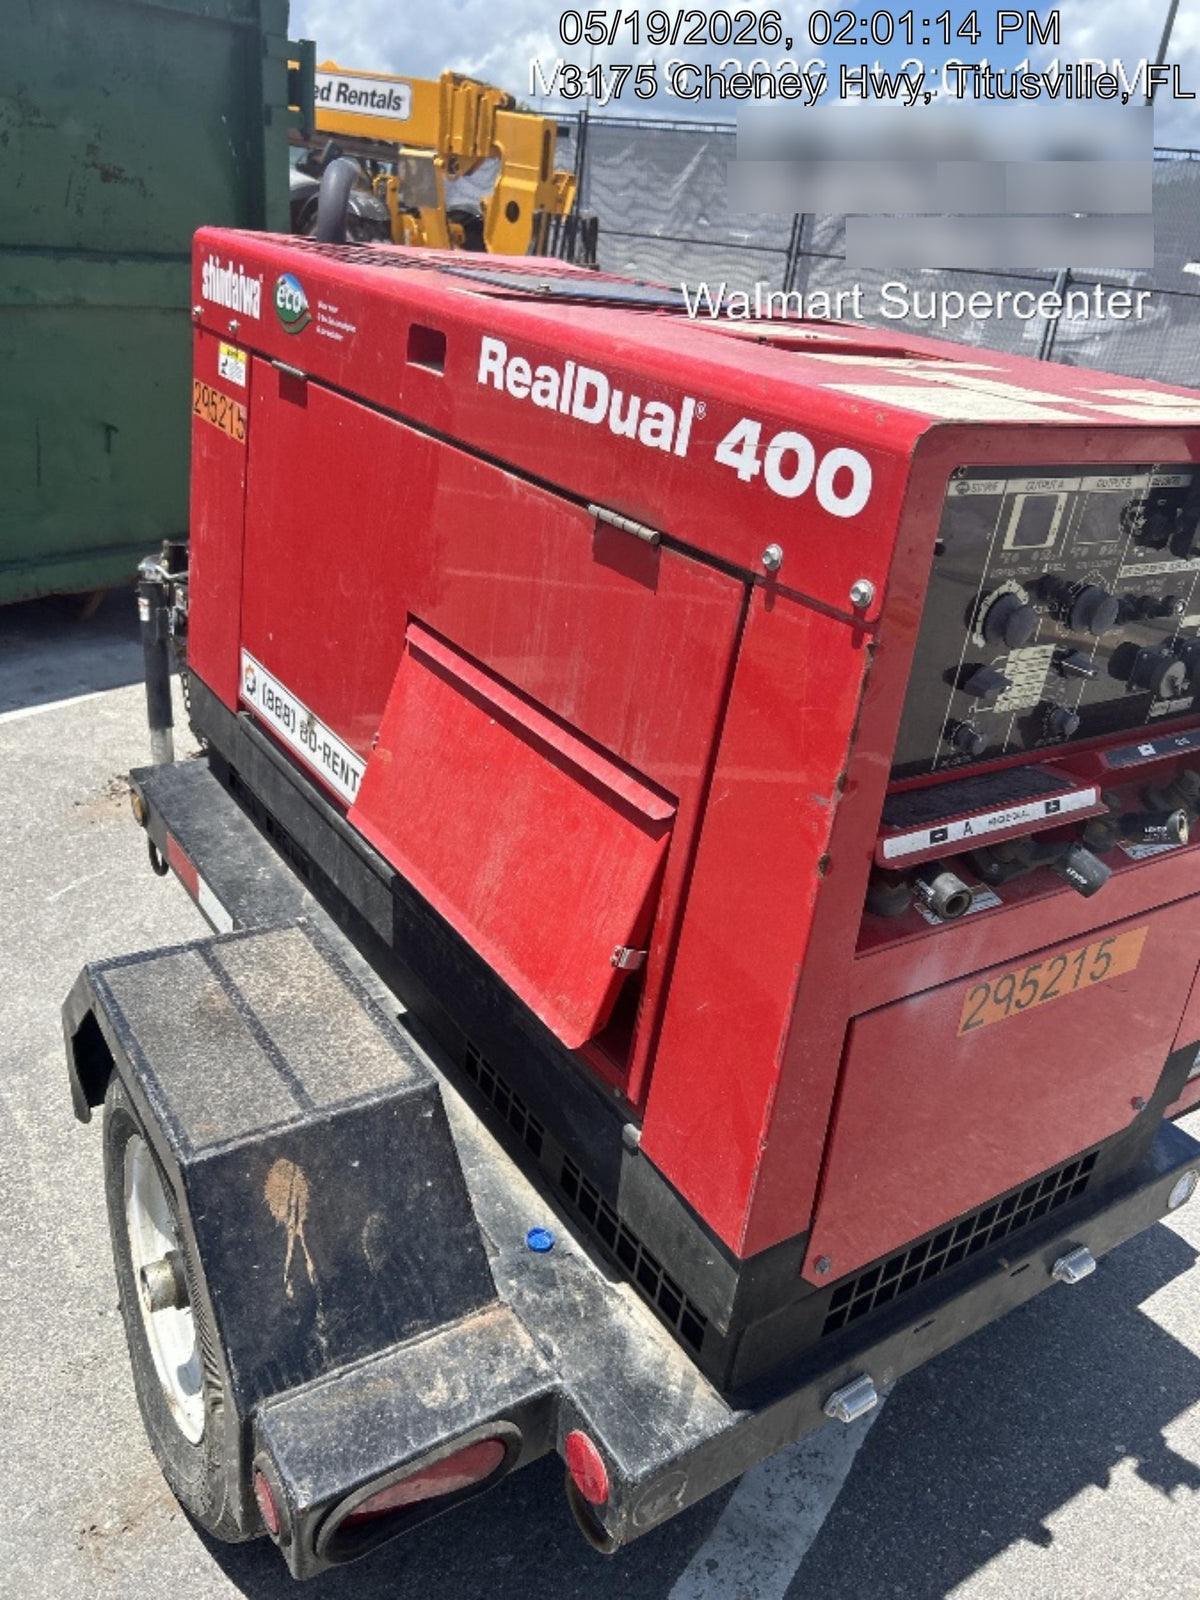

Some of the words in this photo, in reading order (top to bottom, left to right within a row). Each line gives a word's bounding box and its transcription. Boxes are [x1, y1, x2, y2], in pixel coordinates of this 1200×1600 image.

[336, 83, 402, 111] Rentals
[202, 253, 261, 320] shindaiwa
[276, 284, 302, 315] eco
[194, 380, 246, 441] 295215
[715, 417, 872, 518] 400
[961, 937, 1117, 1032] 295215
